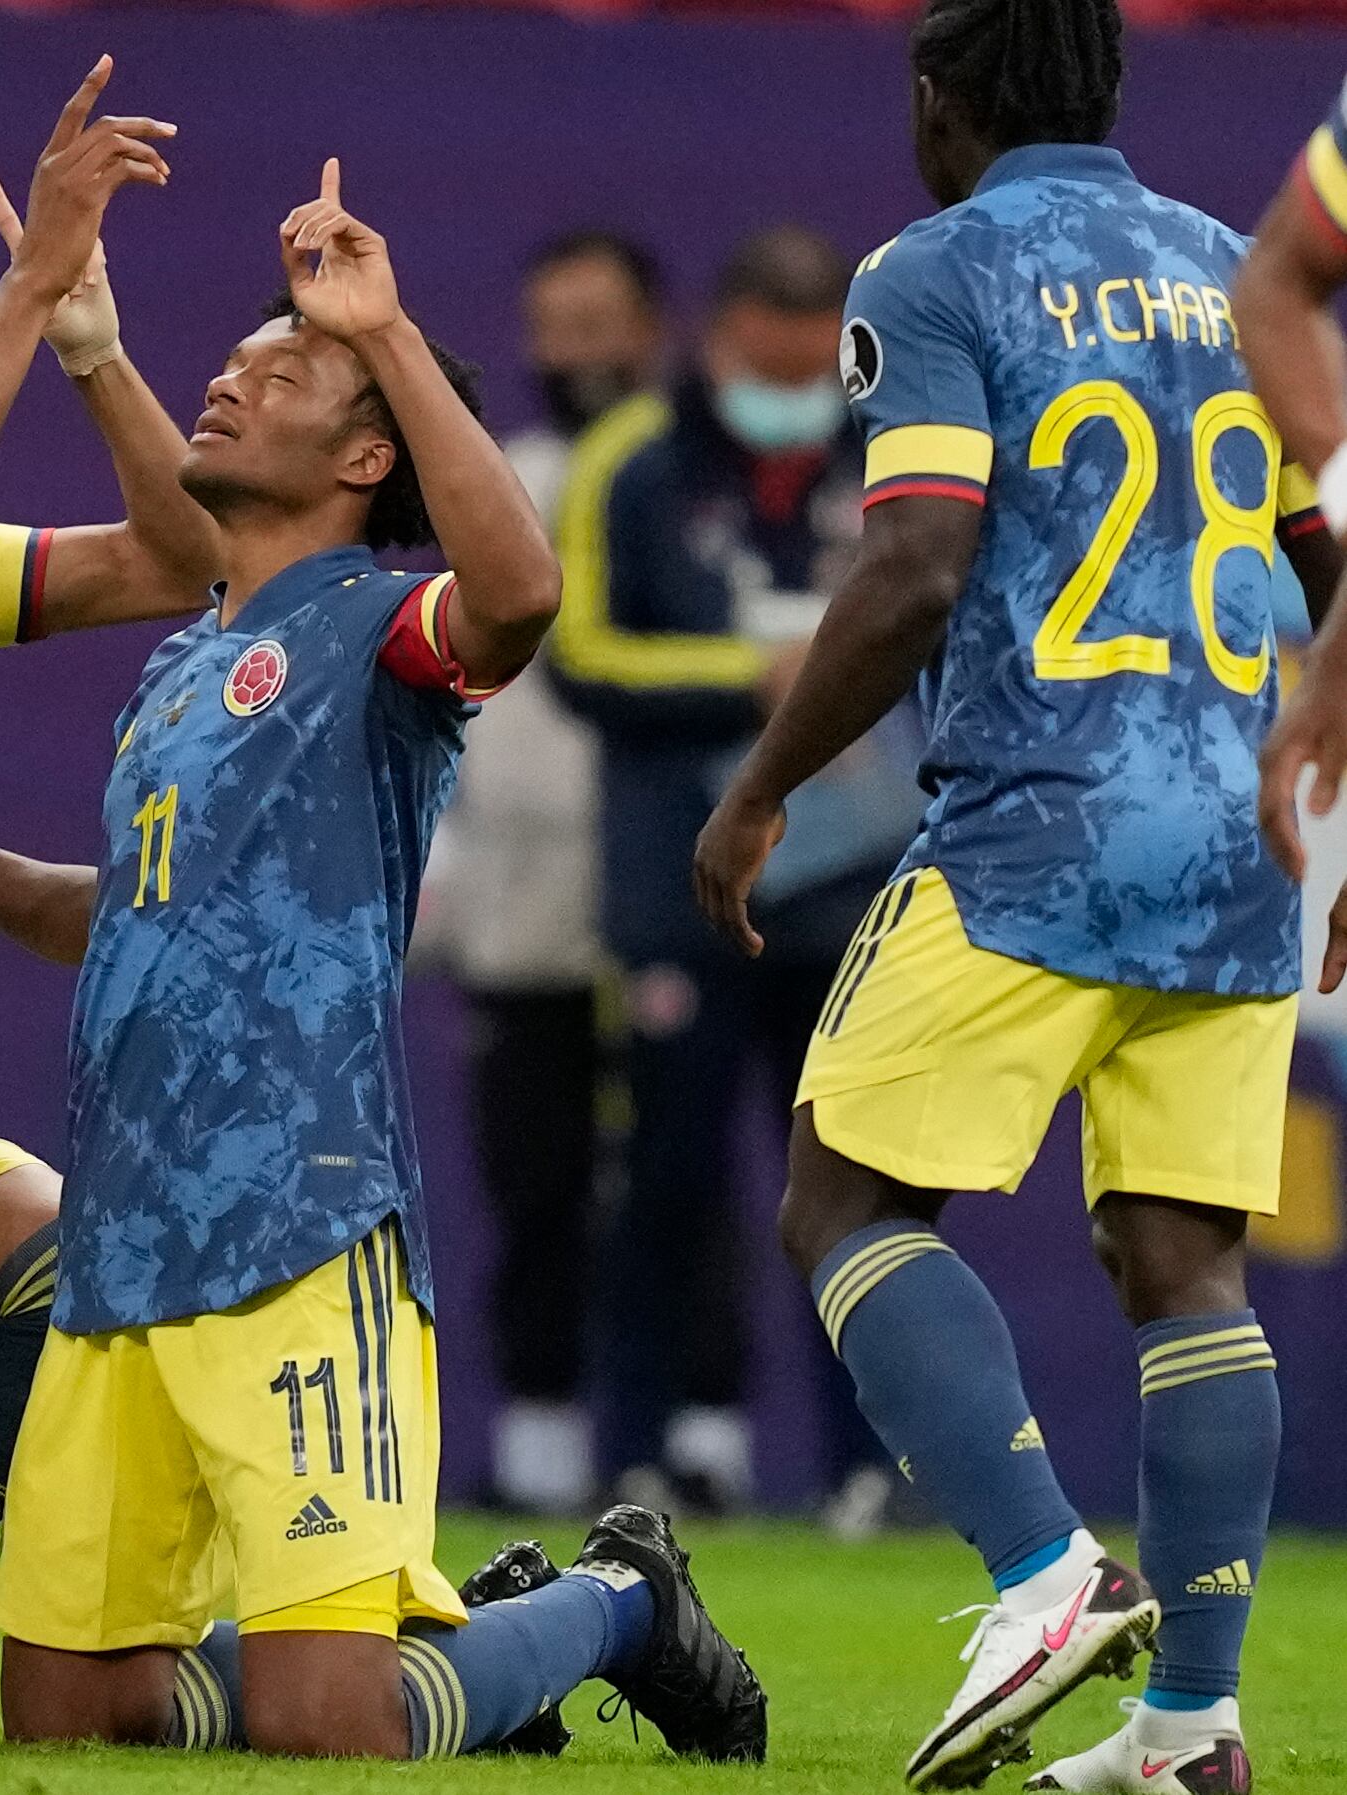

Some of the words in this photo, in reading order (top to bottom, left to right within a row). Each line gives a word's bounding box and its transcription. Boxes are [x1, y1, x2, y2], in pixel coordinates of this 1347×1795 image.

[1028, 379, 1282, 696] 28
[131, 783, 179, 908] 11
[270, 1357, 344, 1477] 11
[285, 1520, 348, 1541] adidas
